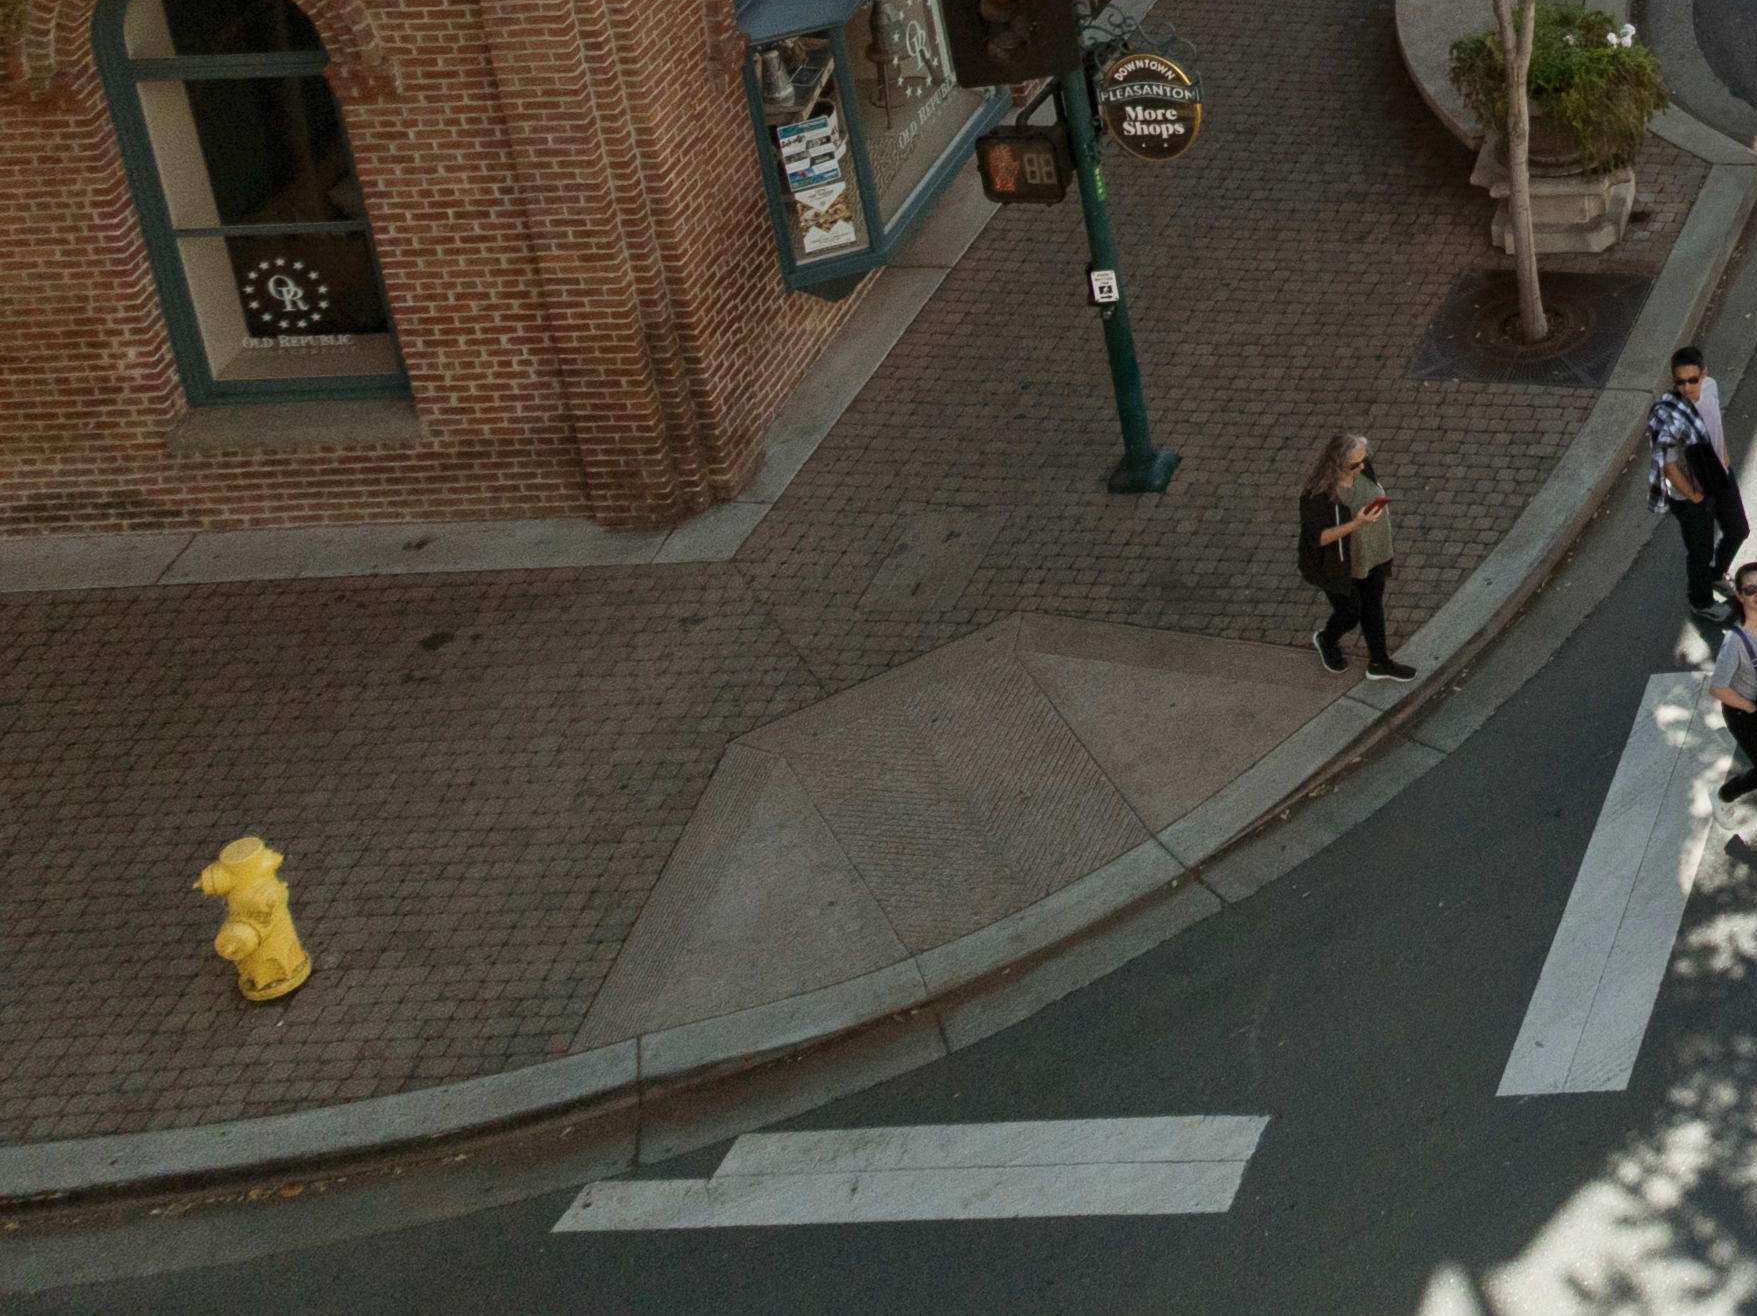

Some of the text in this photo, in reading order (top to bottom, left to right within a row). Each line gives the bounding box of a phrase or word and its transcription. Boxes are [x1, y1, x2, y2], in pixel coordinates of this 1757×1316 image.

[1114, 59, 1175, 81] DOWNTOWN
[1101, 84, 1196, 101] PLEASANTON
[1125, 106, 1178, 121] More
[1122, 121, 1185, 139] Shops
[242, 334, 352, 349] OLD REPUBLIC
